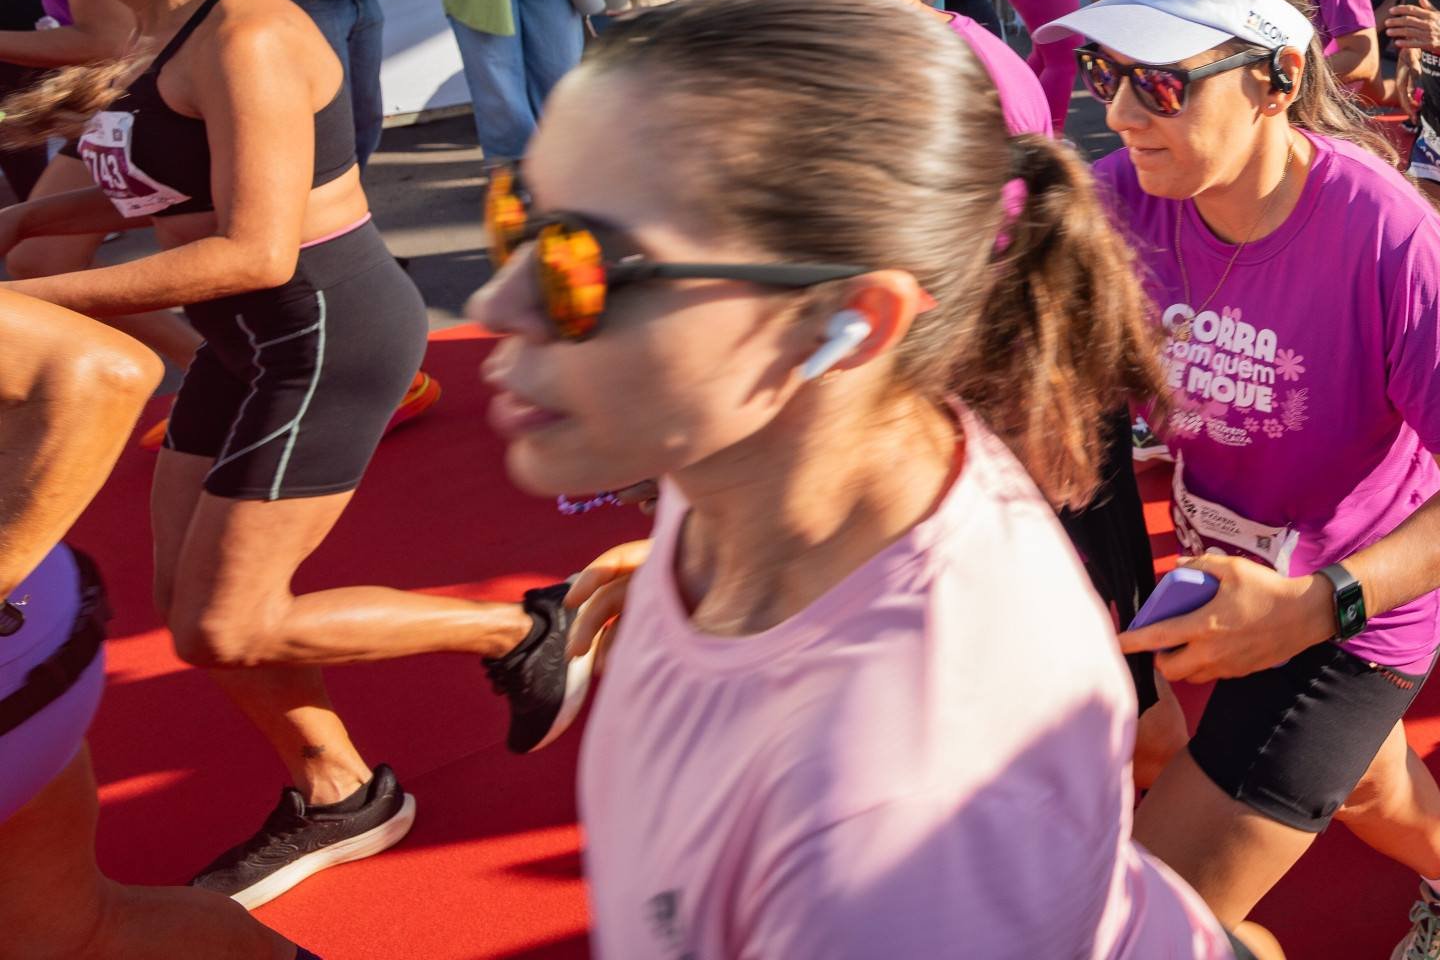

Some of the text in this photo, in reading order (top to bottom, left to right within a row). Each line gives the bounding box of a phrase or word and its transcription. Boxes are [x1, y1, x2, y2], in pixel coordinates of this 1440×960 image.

[1162, 303, 1278, 363] CORRA
[1186, 366, 1273, 413] MOVE
[1212, 352, 1275, 385] quem
